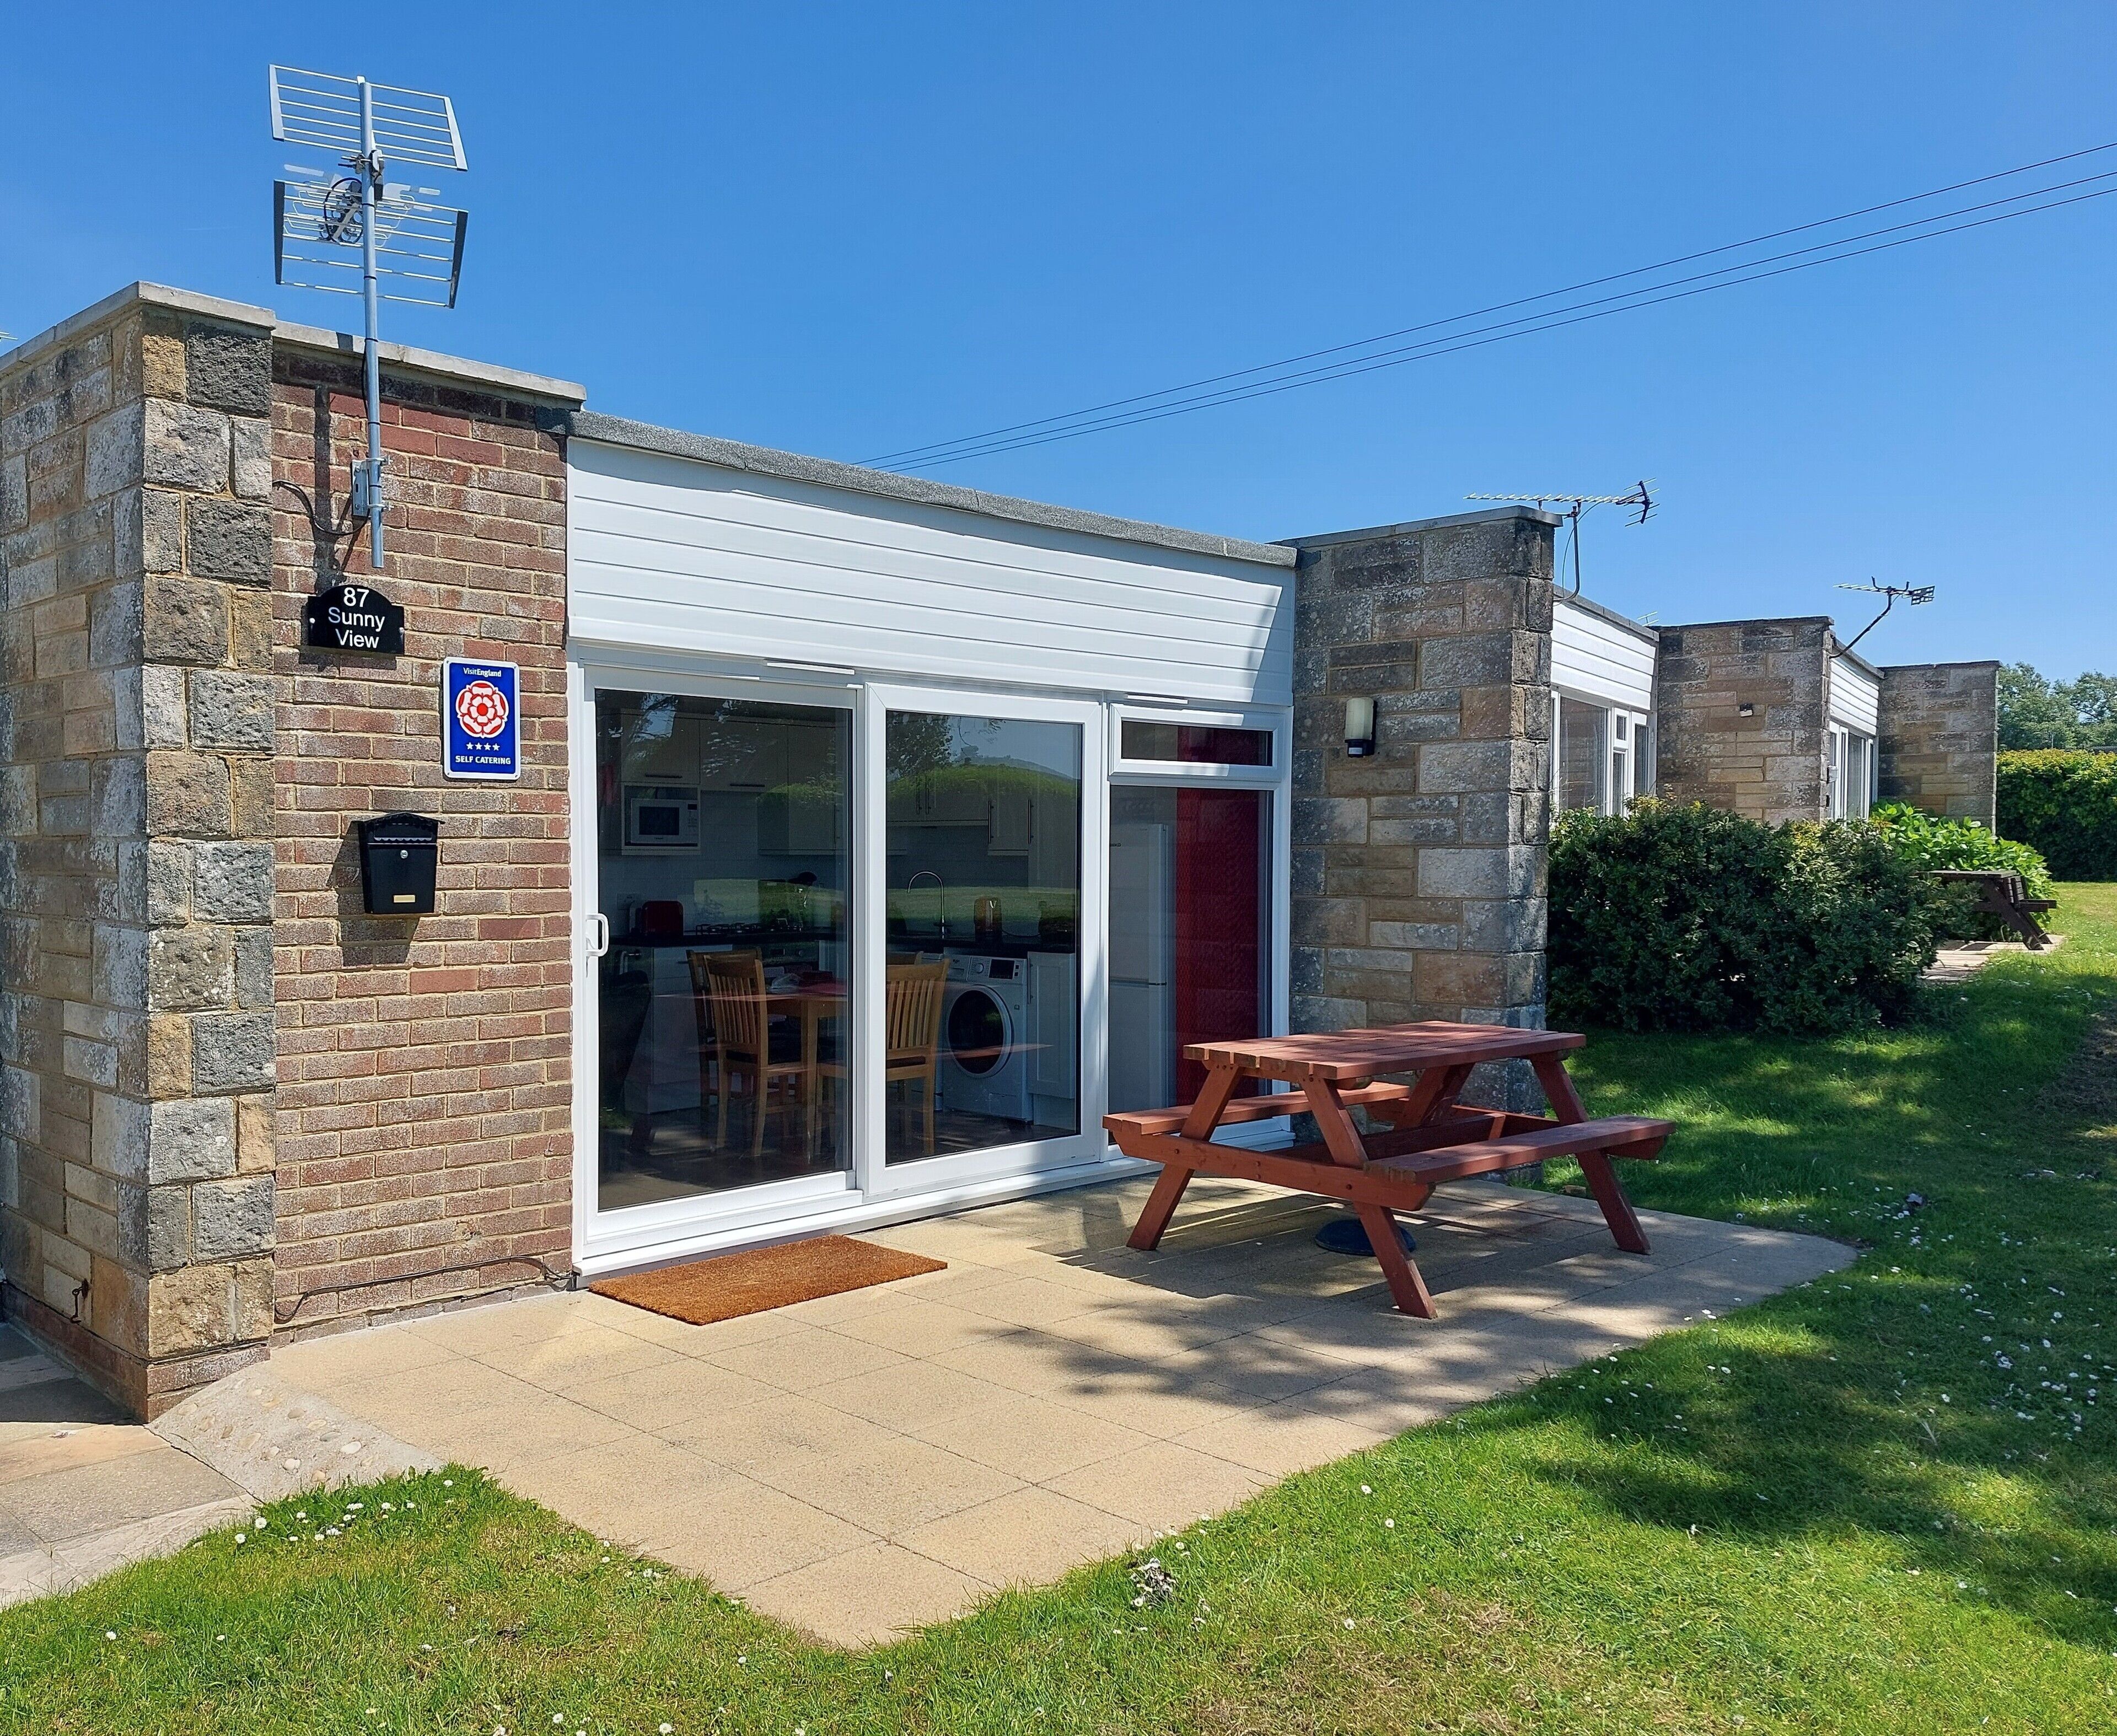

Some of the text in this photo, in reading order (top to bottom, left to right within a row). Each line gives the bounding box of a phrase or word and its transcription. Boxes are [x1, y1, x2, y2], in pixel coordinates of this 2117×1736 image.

[343, 587, 370, 608] 87
[328, 607, 385, 632] Sunny
[335, 628, 380, 649] View
[463, 667, 502, 678] VisitEngland
[475, 756, 511, 765] CATERING
